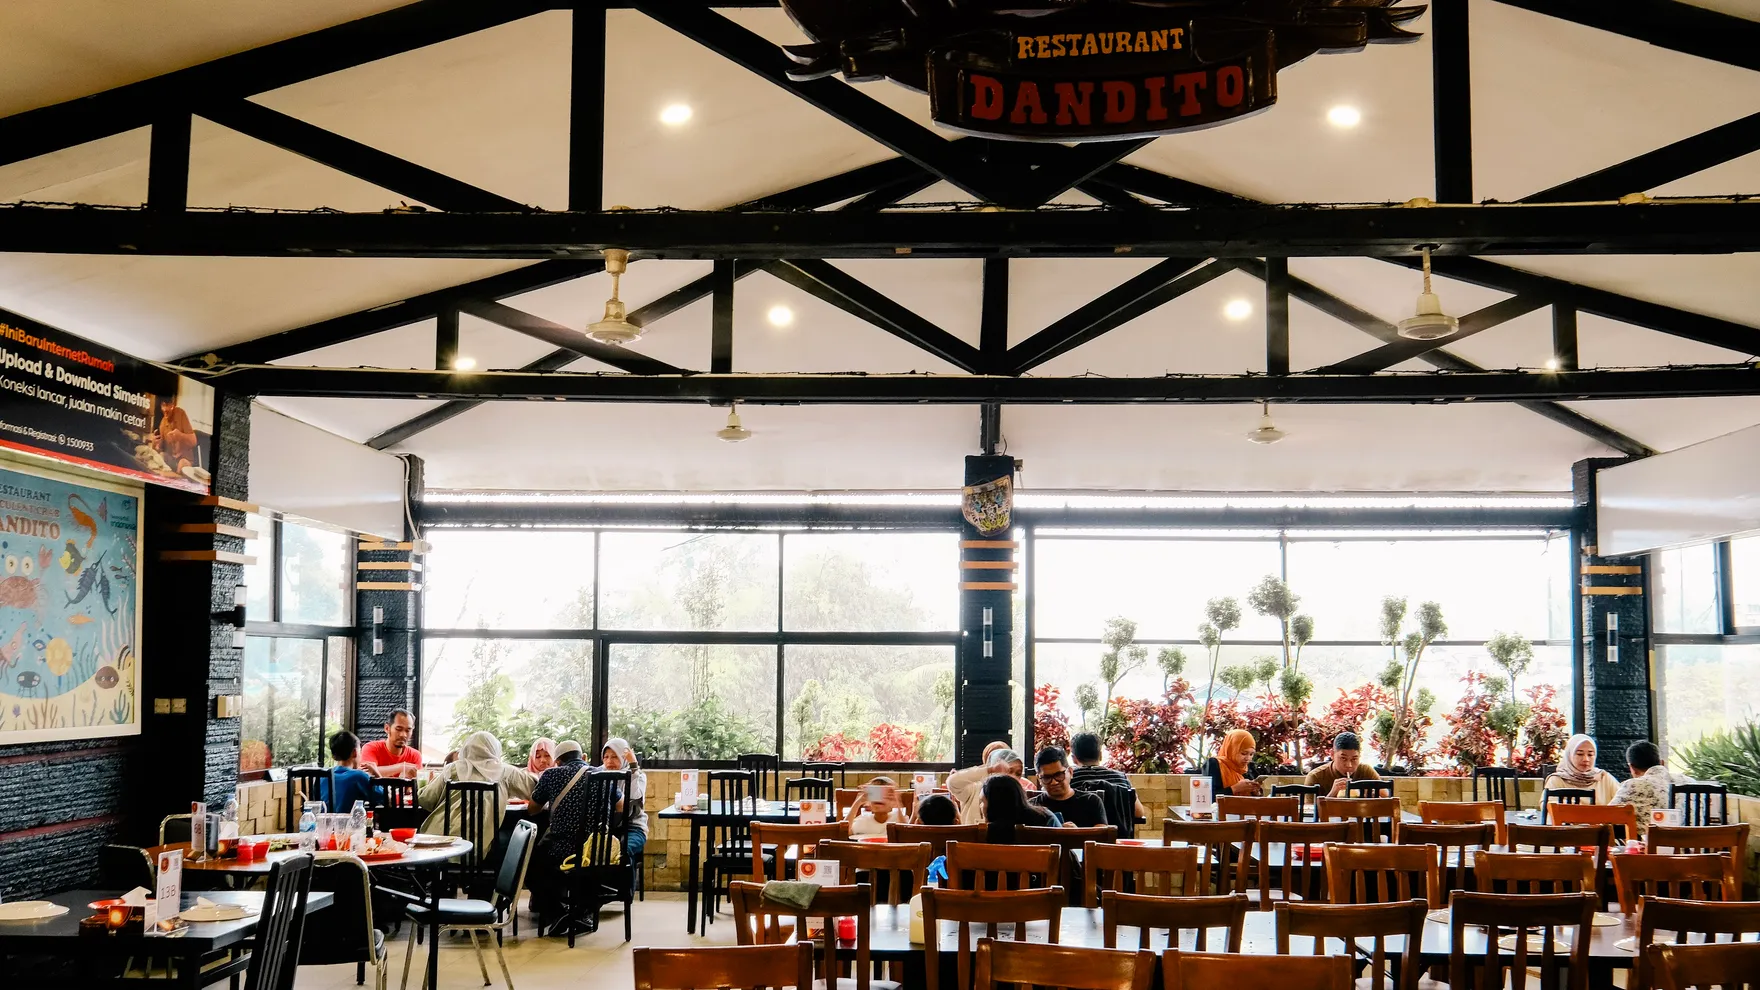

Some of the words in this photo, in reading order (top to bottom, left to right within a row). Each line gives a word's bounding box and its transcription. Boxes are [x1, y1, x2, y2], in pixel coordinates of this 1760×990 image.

[1017, 28, 1184, 59] RESTAURANT
[970, 65, 1245, 125] DANDITO
[0, 323, 115, 373] #IniBaruInternetRumah
[0, 347, 43, 376] Upload
[44, 362, 54, 379] &
[56, 365, 112, 397] Download
[112, 384, 151, 410] Simetris
[36, 385, 68, 409] lancar,
[68, 395, 96, 414] jualan
[96, 405, 123, 421] makin
[122, 413, 146, 429] cetar!
[66, 437, 94, 452] 1500933
[1196, 794, 1206, 803] 11
